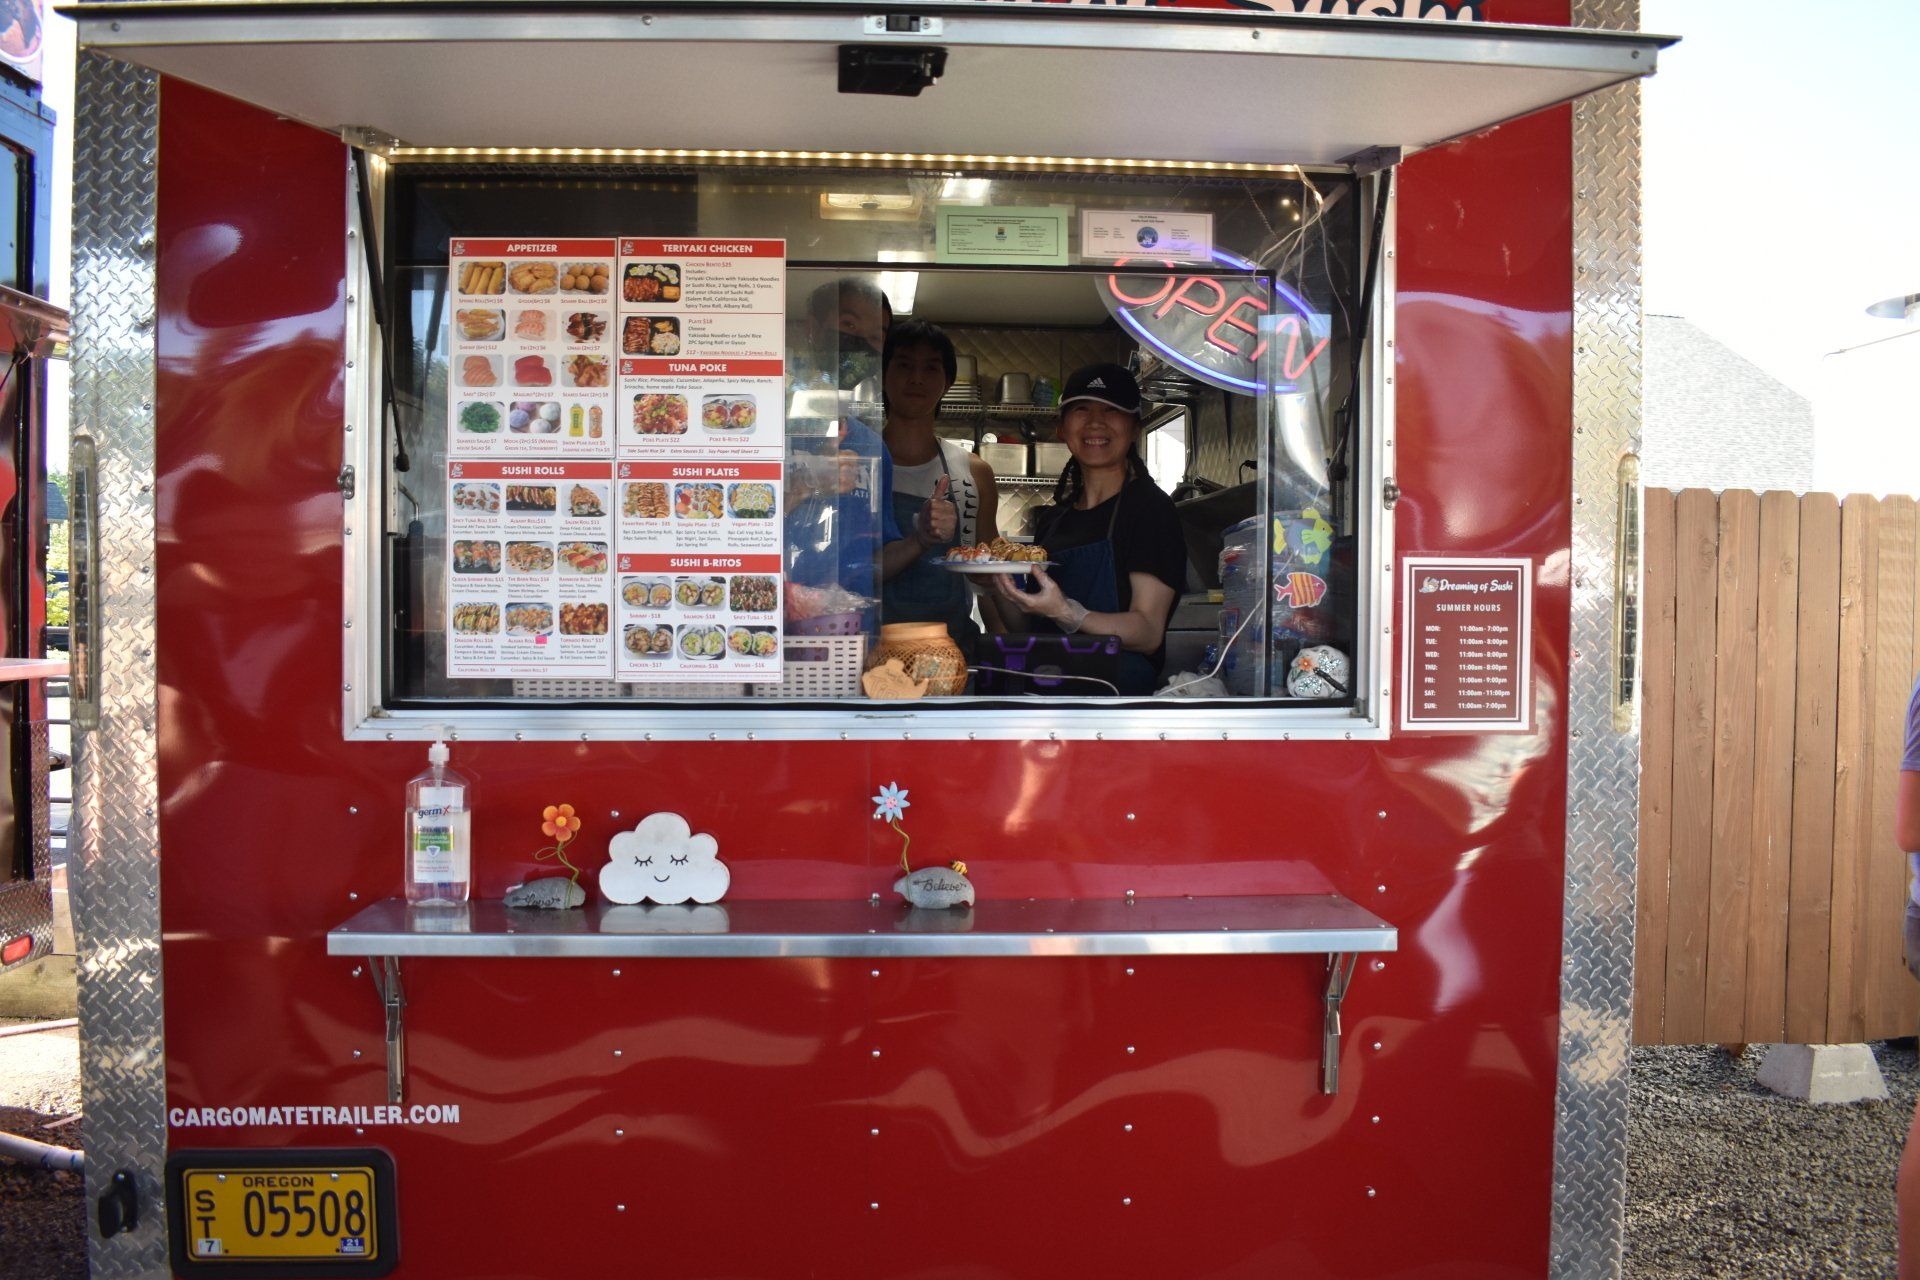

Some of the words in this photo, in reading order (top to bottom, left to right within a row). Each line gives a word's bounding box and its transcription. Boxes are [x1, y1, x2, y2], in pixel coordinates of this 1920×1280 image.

[507, 244, 558, 252] APPETIZER
[663, 244, 706, 252] TERIYAKI
[710, 244, 752, 252] CHICKEN
[1107, 256, 1329, 380] OPEN
[669, 363, 697, 372] TUNA
[700, 363, 727, 372] POKE
[502, 466, 532, 474] SUSHI
[534, 466, 565, 474] ROLLS
[672, 468, 702, 476] SUSHI
[706, 468, 740, 476] PLATES
[670, 558, 700, 567] SUSHI
[703, 558, 742, 567] B-RITOS
[1439, 578, 1478, 593] Dreaming
[1480, 582, 1488, 593] of
[1490, 580, 1513, 591] Sushi
[923, 878, 962, 892] Believe
[169, 1105, 460, 1126] CARGOMATETRAILER.COM
[242, 1176, 314, 1188] OREGON
[244, 1190, 366, 1237] 05508
[205, 1240, 214, 1252] 7
